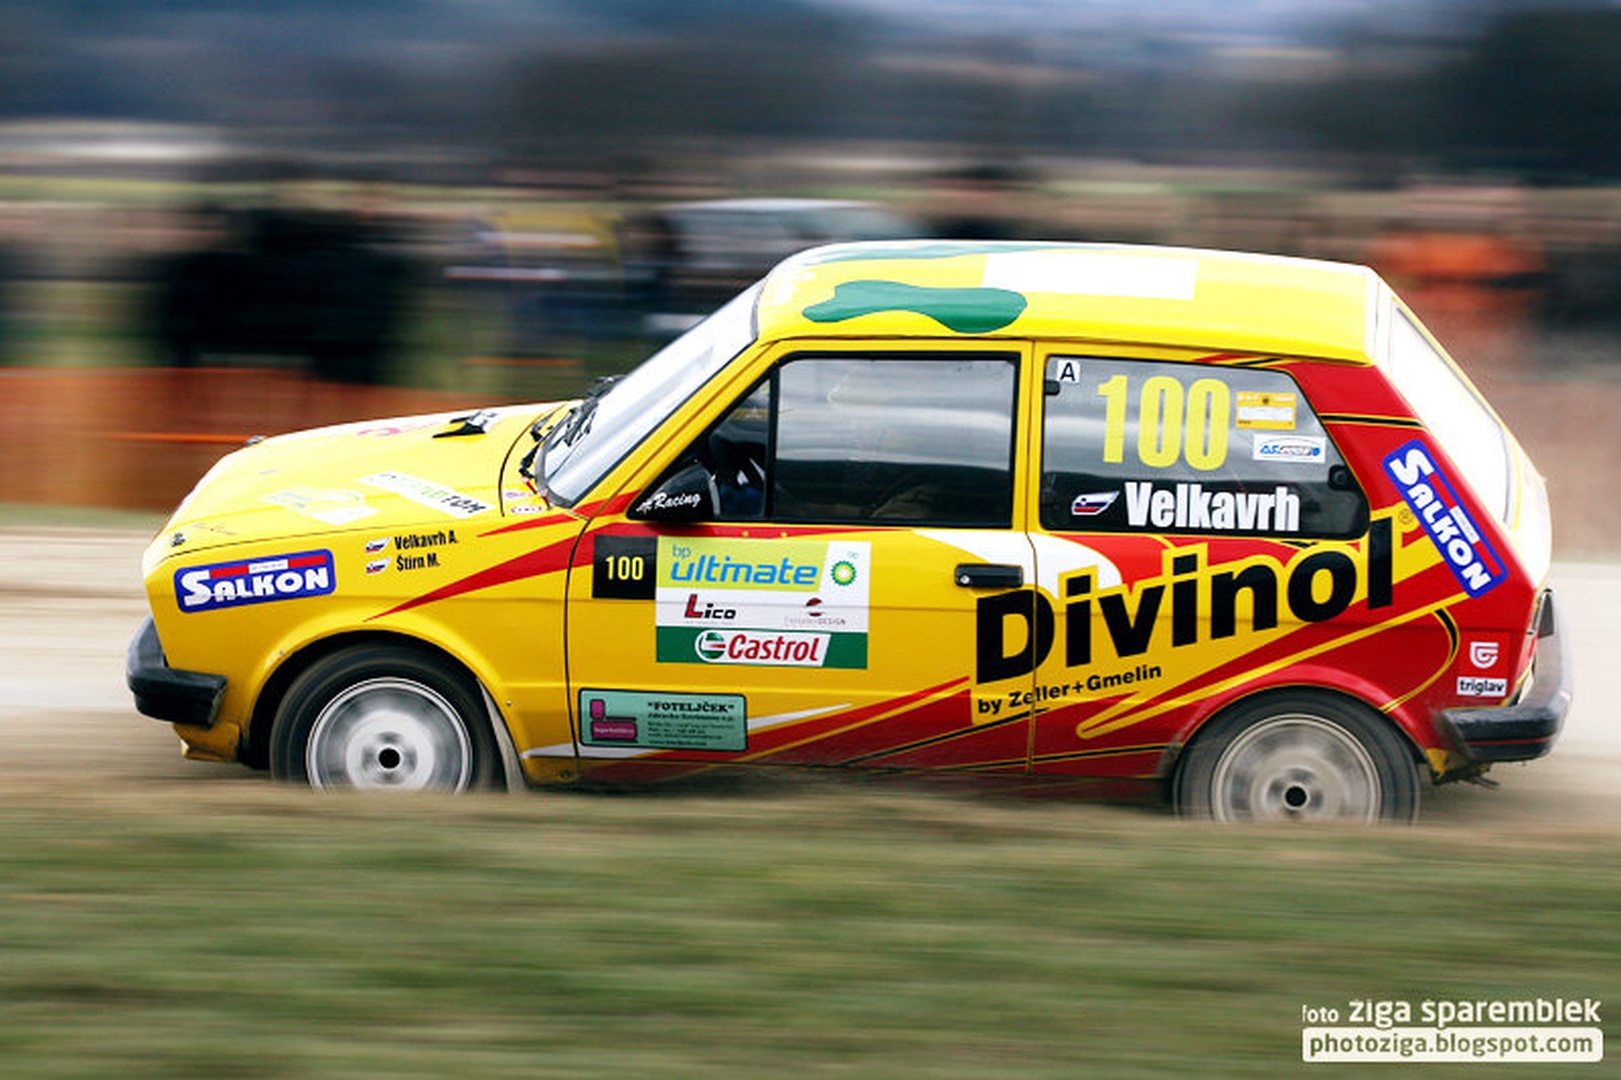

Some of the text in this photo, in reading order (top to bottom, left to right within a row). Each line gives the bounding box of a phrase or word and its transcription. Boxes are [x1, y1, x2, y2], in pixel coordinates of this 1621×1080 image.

[1060, 362, 1076, 381] A
[1097, 374, 1231, 471] 100
[653, 491, 701, 510] Racing
[1124, 481, 1300, 532] Velkavrh
[394, 530, 447, 550] Velkavrh
[671, 543, 692, 559] bp
[605, 555, 645, 580] 100
[670, 555, 819, 585] ultimate
[684, 593, 737, 620] Lico
[975, 515, 1394, 685] Divinol
[728, 634, 821, 662] Castrol
[977, 663, 1162, 715] by Zeller+Gmelin
[1459, 679, 1505, 696] triglav
